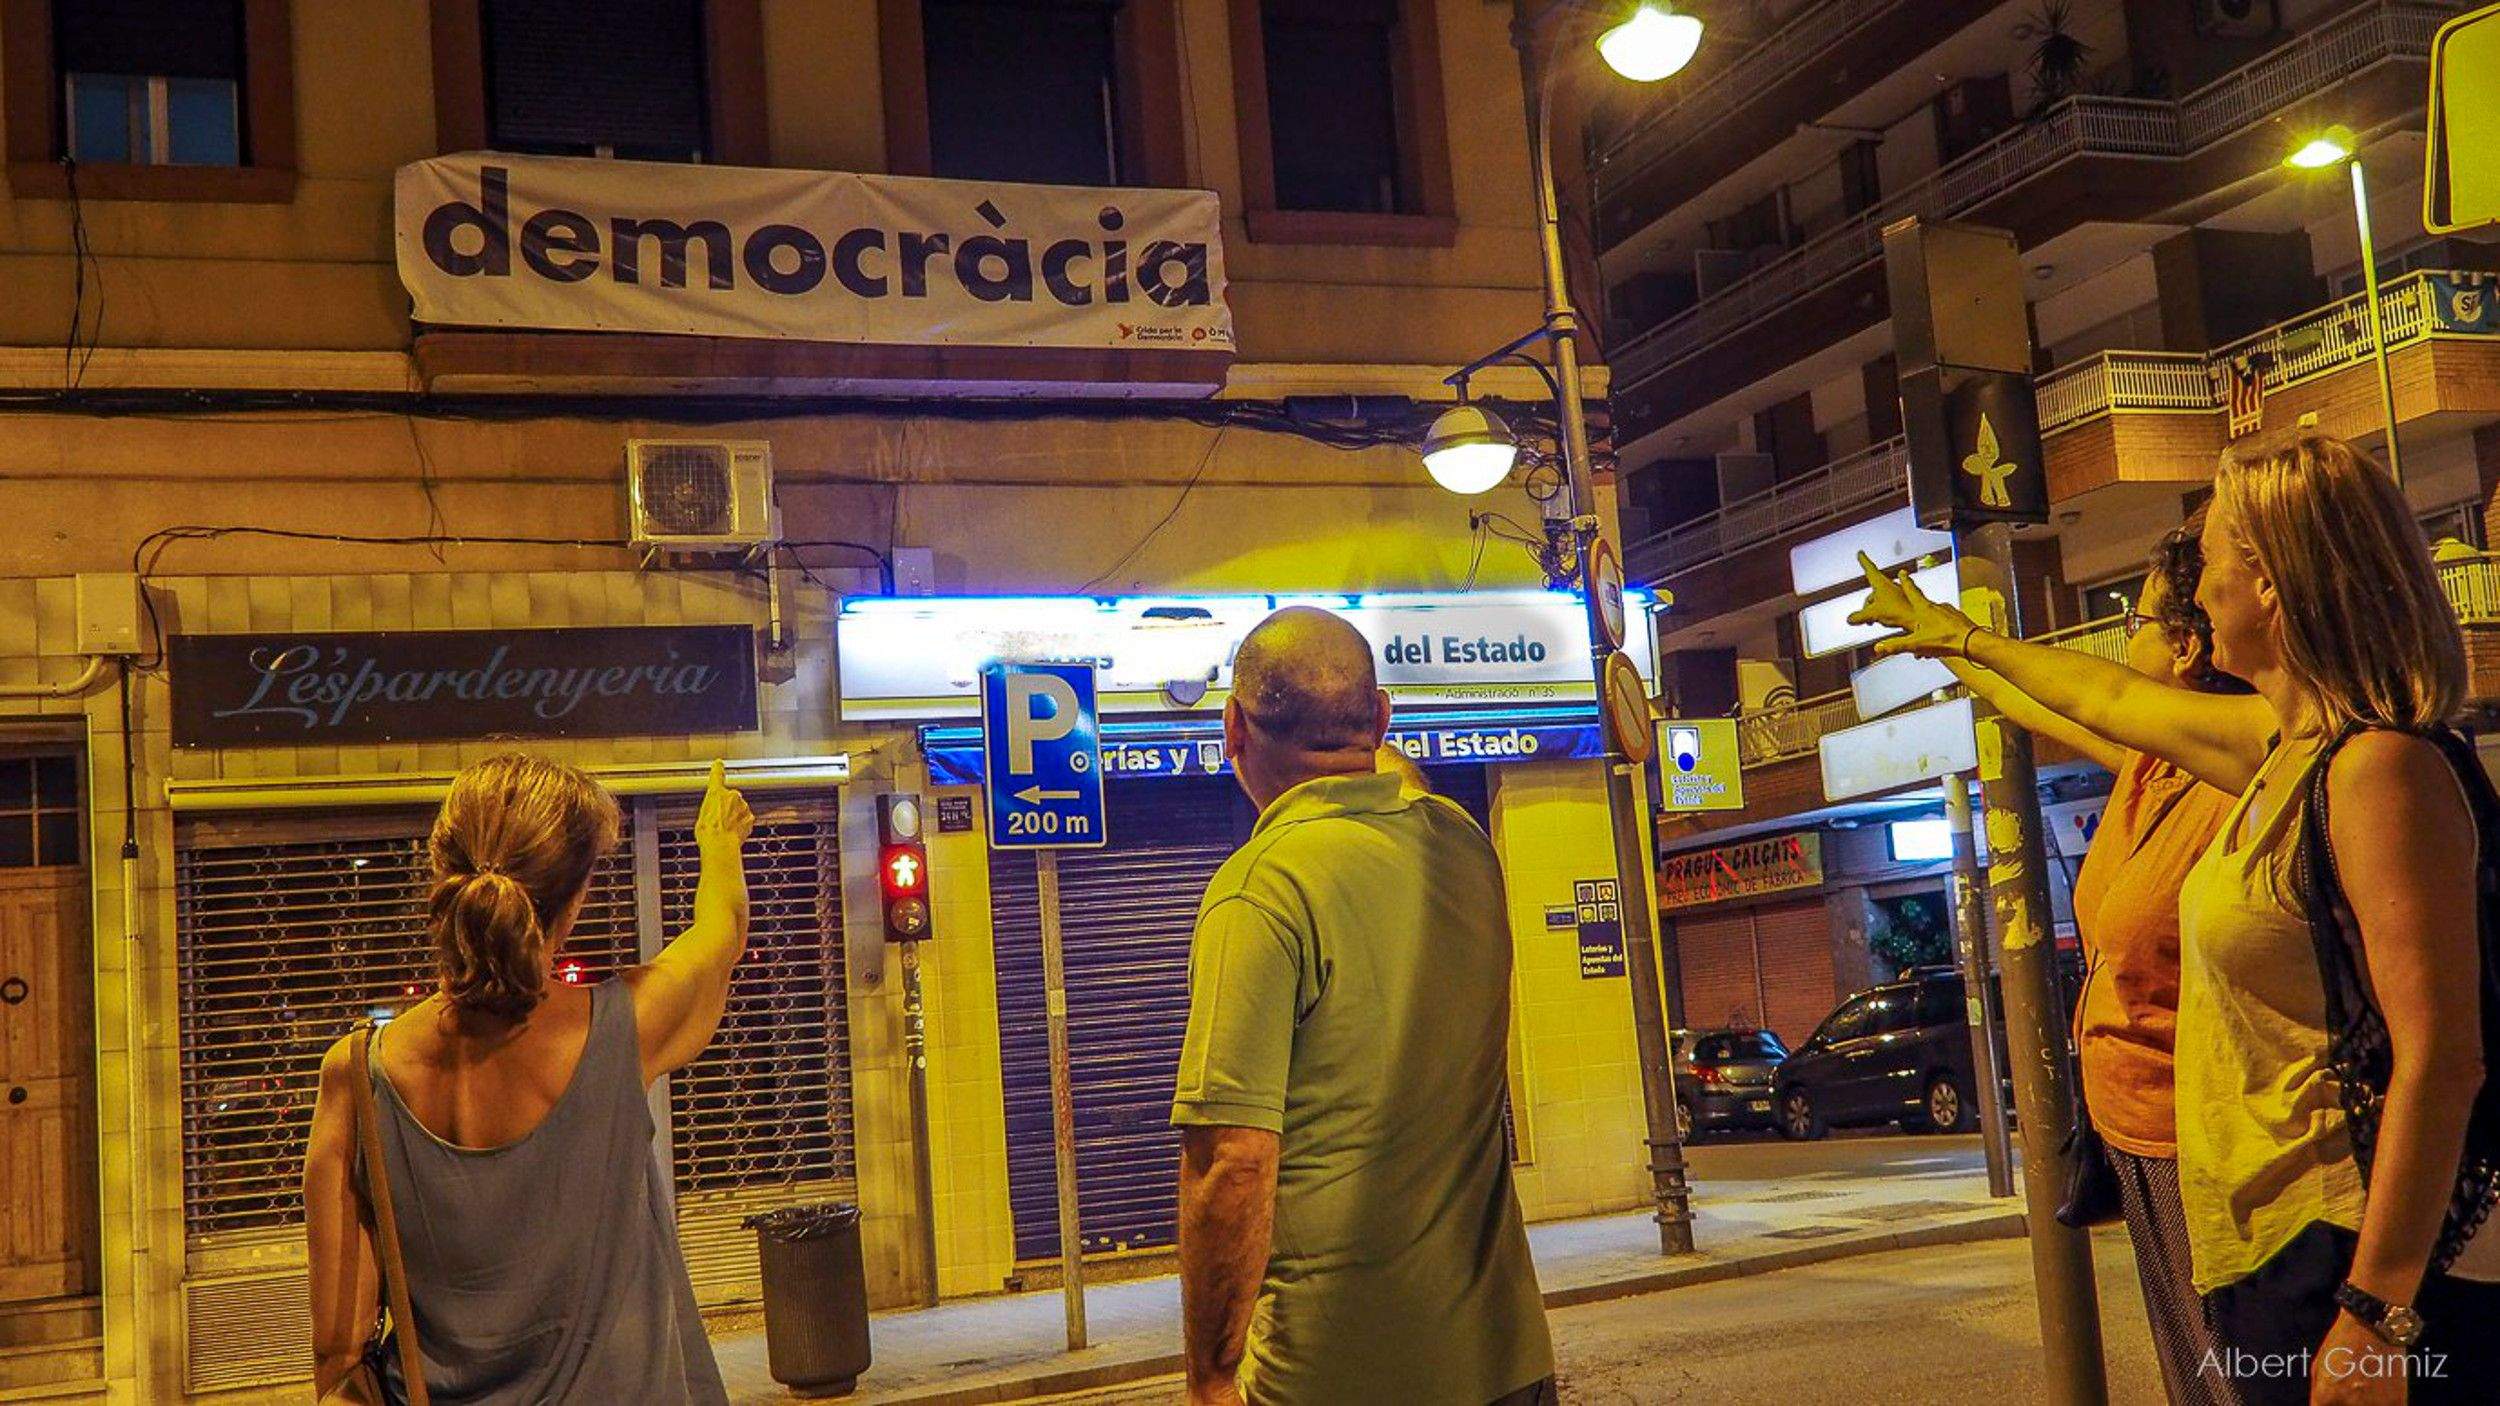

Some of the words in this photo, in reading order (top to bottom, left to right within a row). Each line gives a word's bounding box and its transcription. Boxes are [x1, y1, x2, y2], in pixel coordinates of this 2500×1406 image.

[422, 166, 1212, 306] democràcia
[1384, 634, 1432, 665] del
[1442, 634, 1546, 664] Estado
[1006, 673, 1079, 775] P
[1101, 746, 1161, 771] rías
[1169, 747, 1189, 774] y
[1439, 728, 1540, 758] Estado
[1008, 811, 1059, 835] 200
[1065, 814, 1089, 835] m
